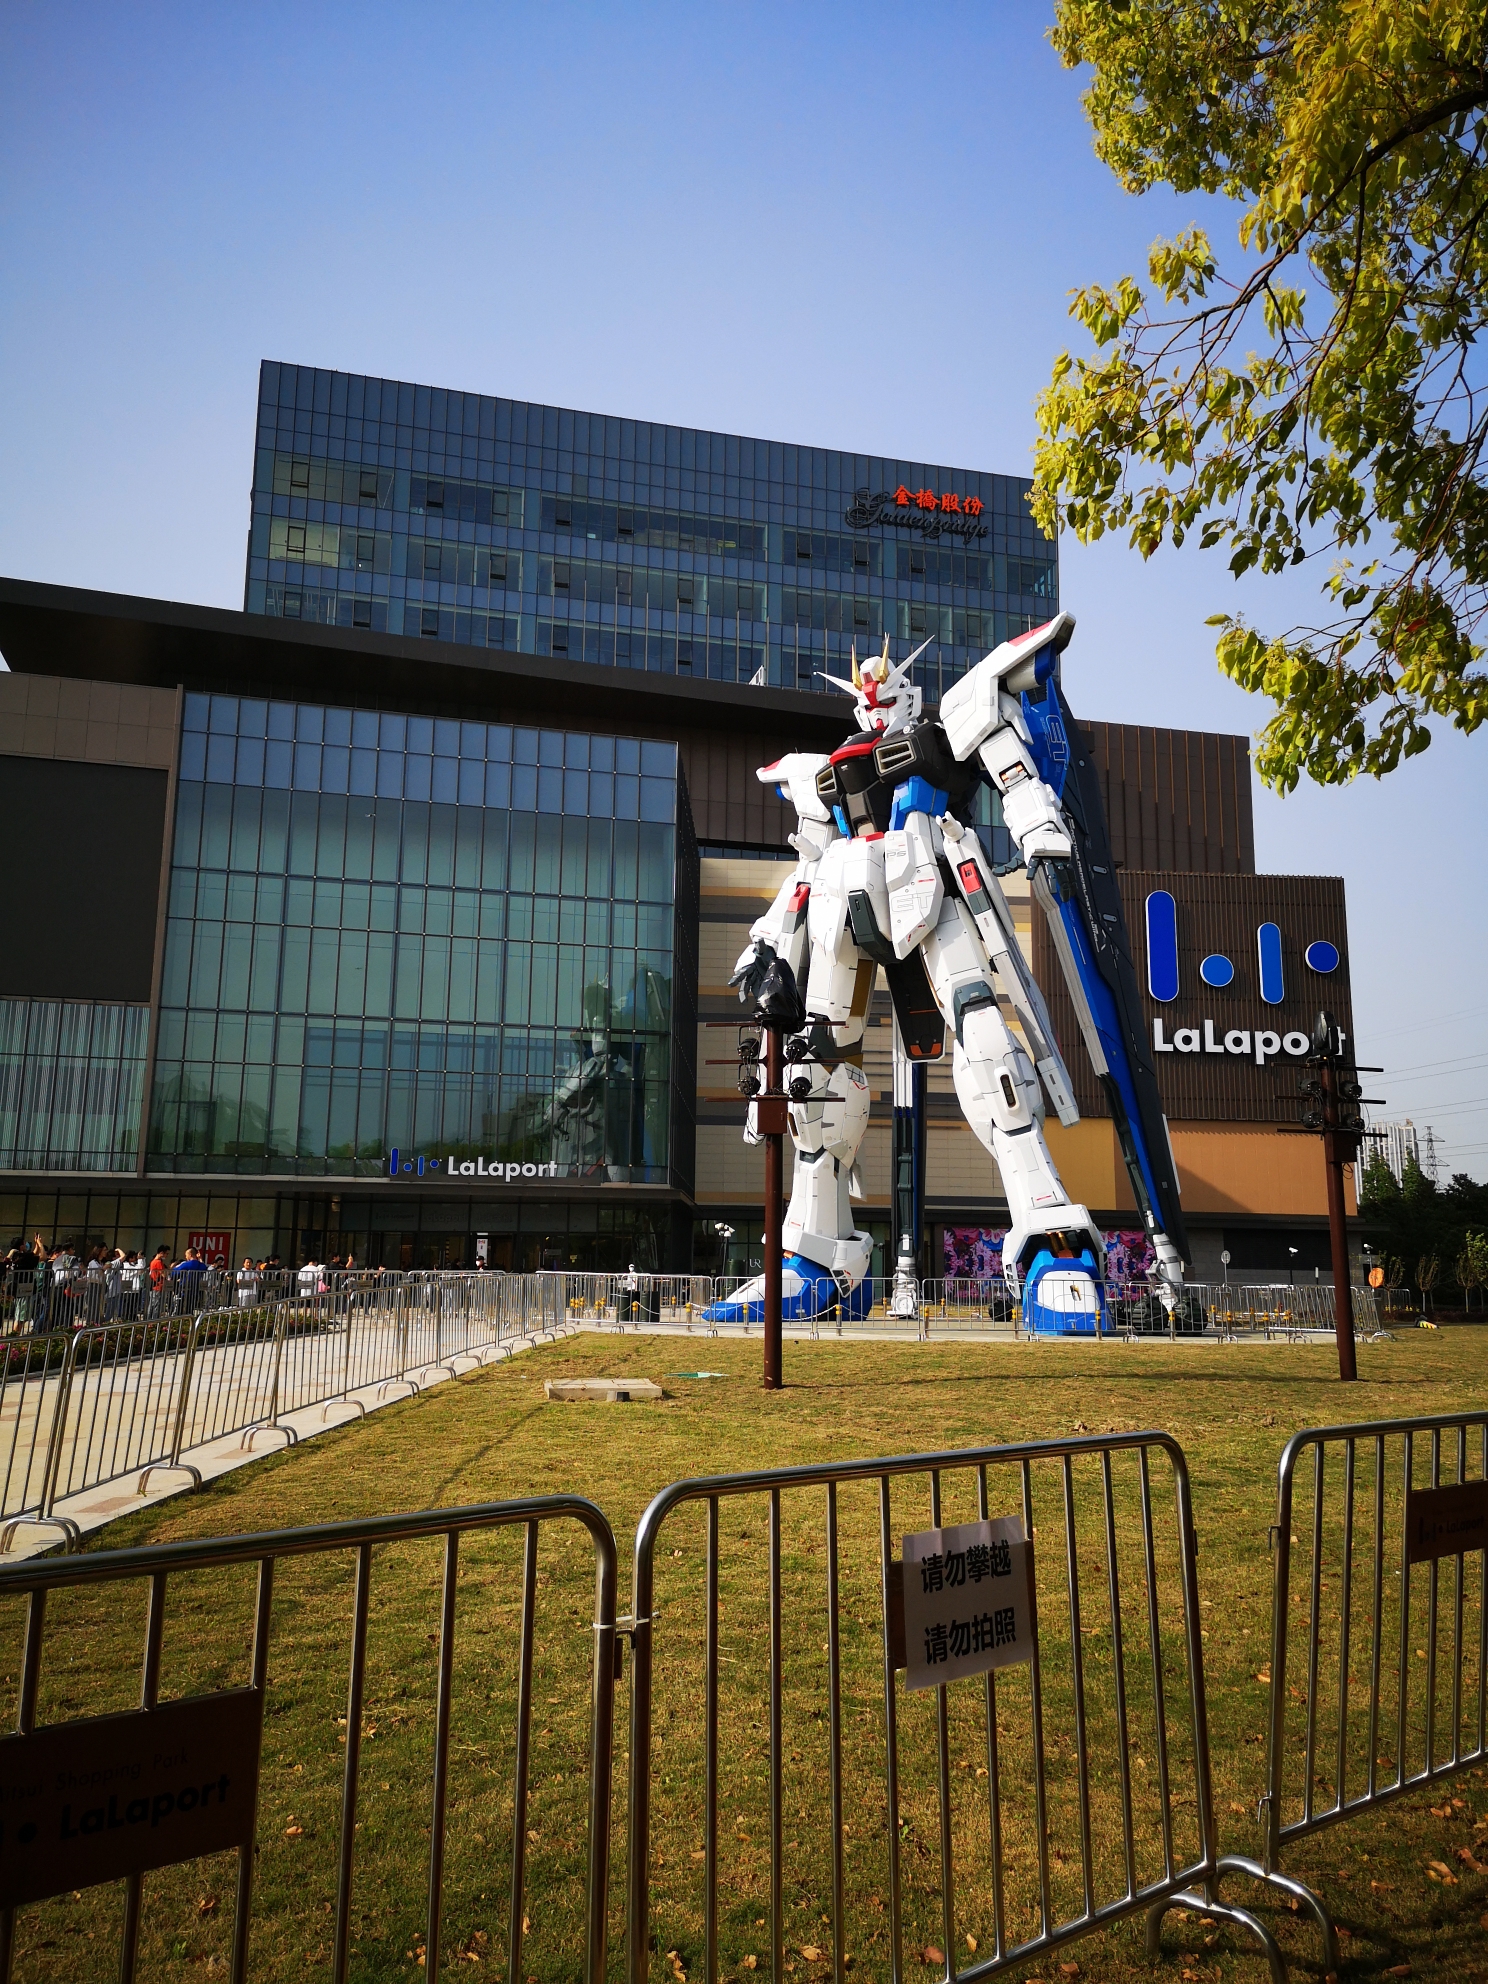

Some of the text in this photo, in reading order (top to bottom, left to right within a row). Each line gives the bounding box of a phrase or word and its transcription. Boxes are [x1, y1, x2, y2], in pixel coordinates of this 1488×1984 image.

[1153, 1017, 1347, 1066] LaLapot
[447, 1155, 557, 1183] LaLaport
[192, 1236, 224, 1251] UNI
[921, 1539, 1012, 1594] 请勿攀越
[924, 1606, 1017, 1665] 请勿拍照
[55, 1762, 142, 1792] Shopping
[153, 1746, 189, 1771] Park
[59, 1773, 231, 1841] LaLaport
